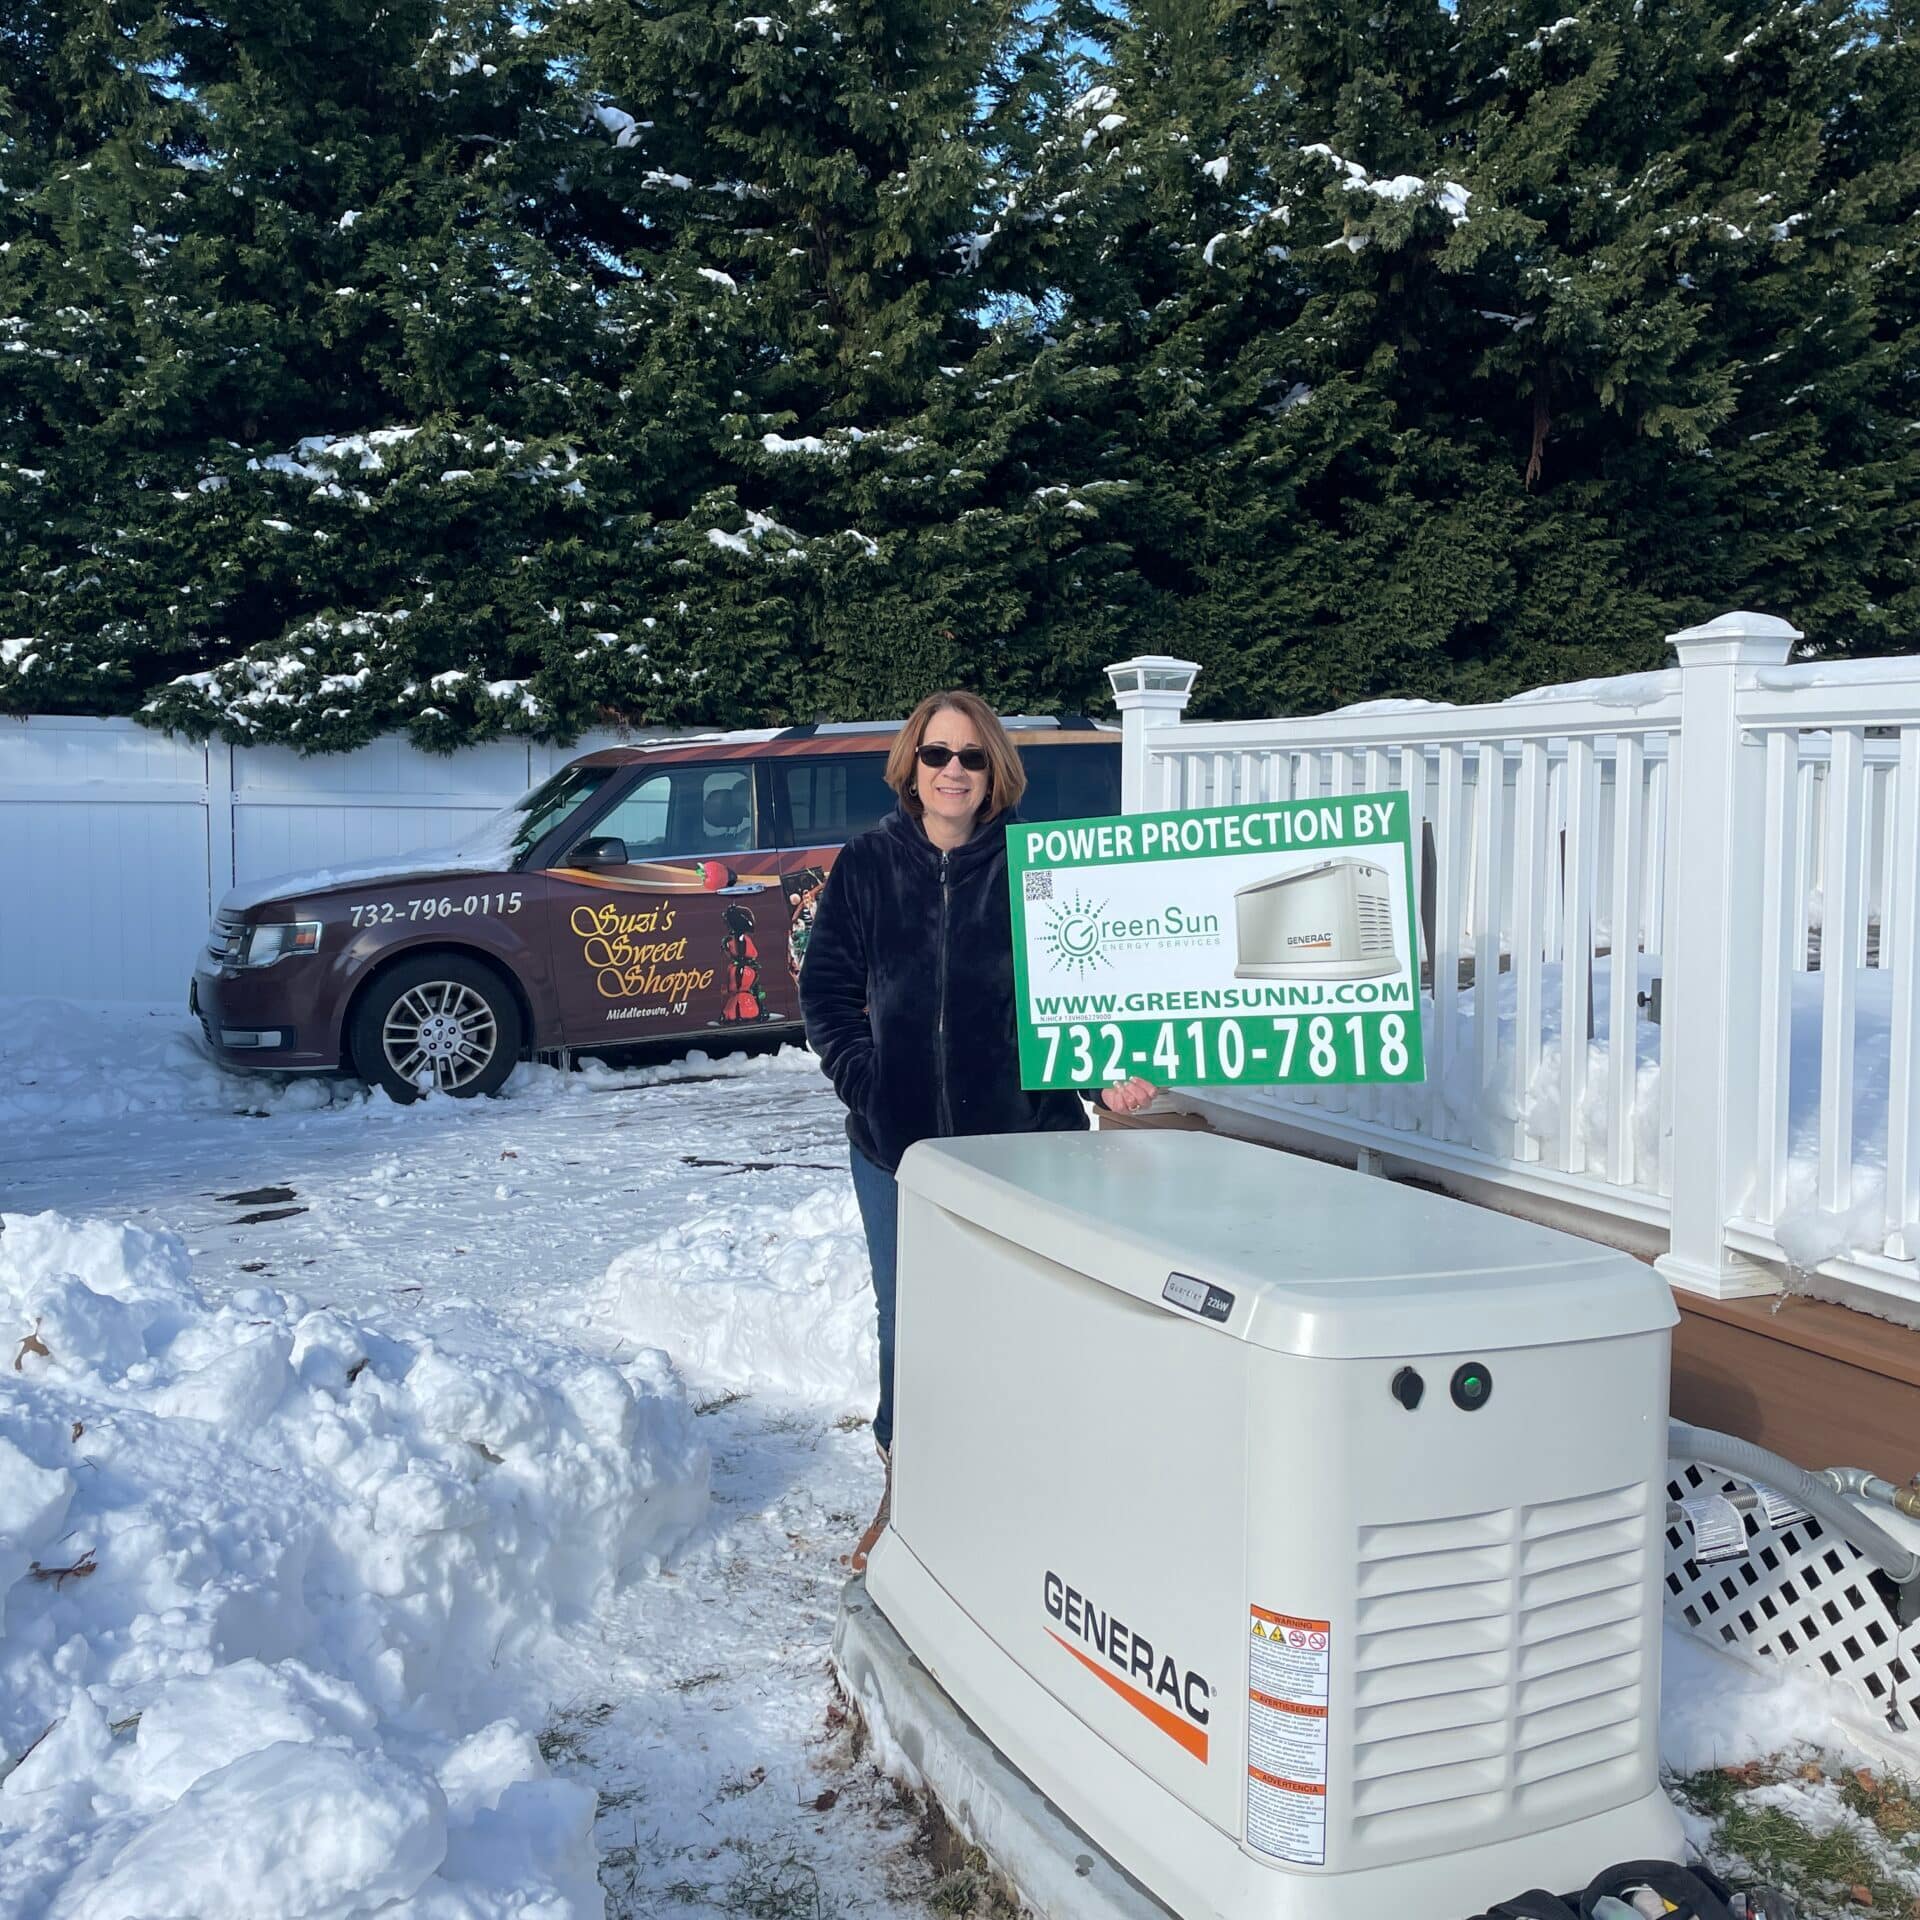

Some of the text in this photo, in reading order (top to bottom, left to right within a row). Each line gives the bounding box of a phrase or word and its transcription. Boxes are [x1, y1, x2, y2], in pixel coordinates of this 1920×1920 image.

[1026, 802, 1396, 864] POWER PROTECTION BY
[350, 891, 522, 928] 732-796-0115
[570, 900, 677, 937] Suzi's
[584, 934, 688, 968] Sweet
[1102, 937, 1221, 952] ENERGY SERVICES
[1287, 932, 1332, 945] GENERAC
[597, 964, 714, 1003] Shoppe
[1035, 981, 1410, 1016] WWW.GREENSUNNJ.COM
[606, 1002, 688, 1021] Middletown, NJ
[1037, 1013, 1409, 1083] 732-410-7818
[1275, 1616, 1313, 1630] WARNING
[1044, 1570, 1210, 1726] GENERAC
[1262, 1774, 1319, 1793] ADVERTENCIA
